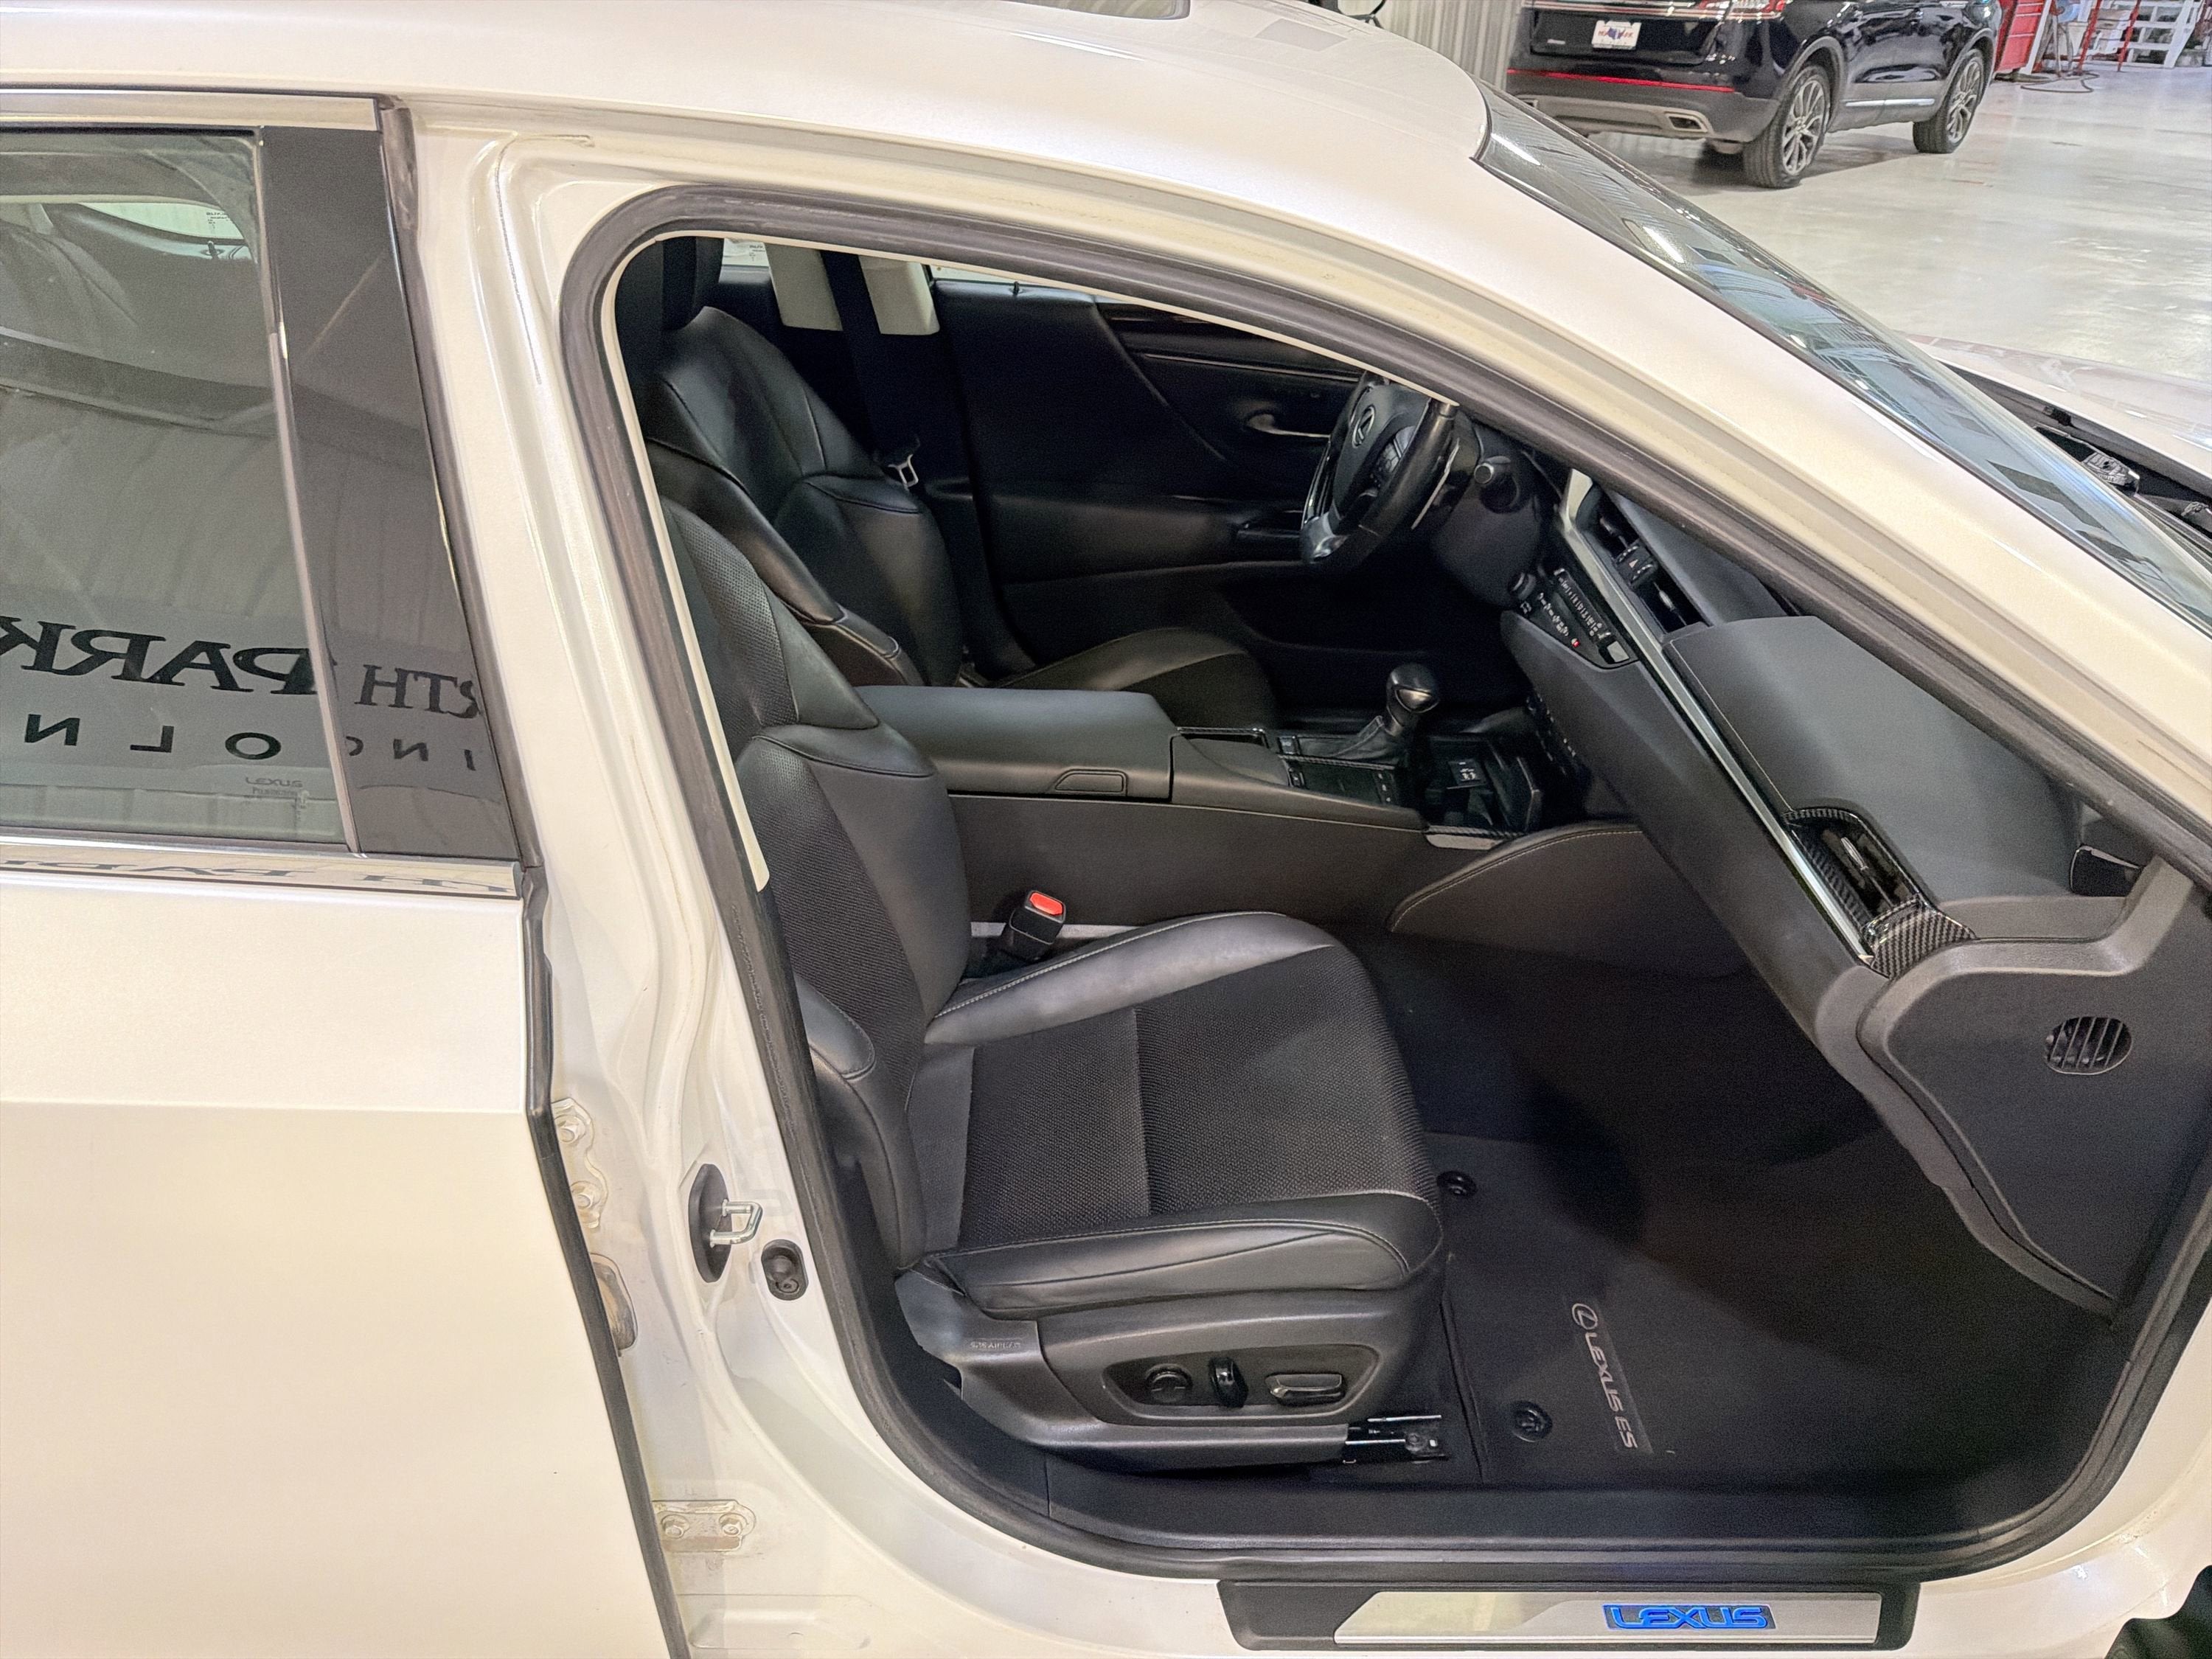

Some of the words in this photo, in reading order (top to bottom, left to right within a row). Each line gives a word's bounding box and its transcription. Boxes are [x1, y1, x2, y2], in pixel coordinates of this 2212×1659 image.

[1585, 1332, 1624, 1412] LEXUS
[1614, 1416, 1638, 1449] ES
[1611, 1606, 1767, 1630] LEXUS
